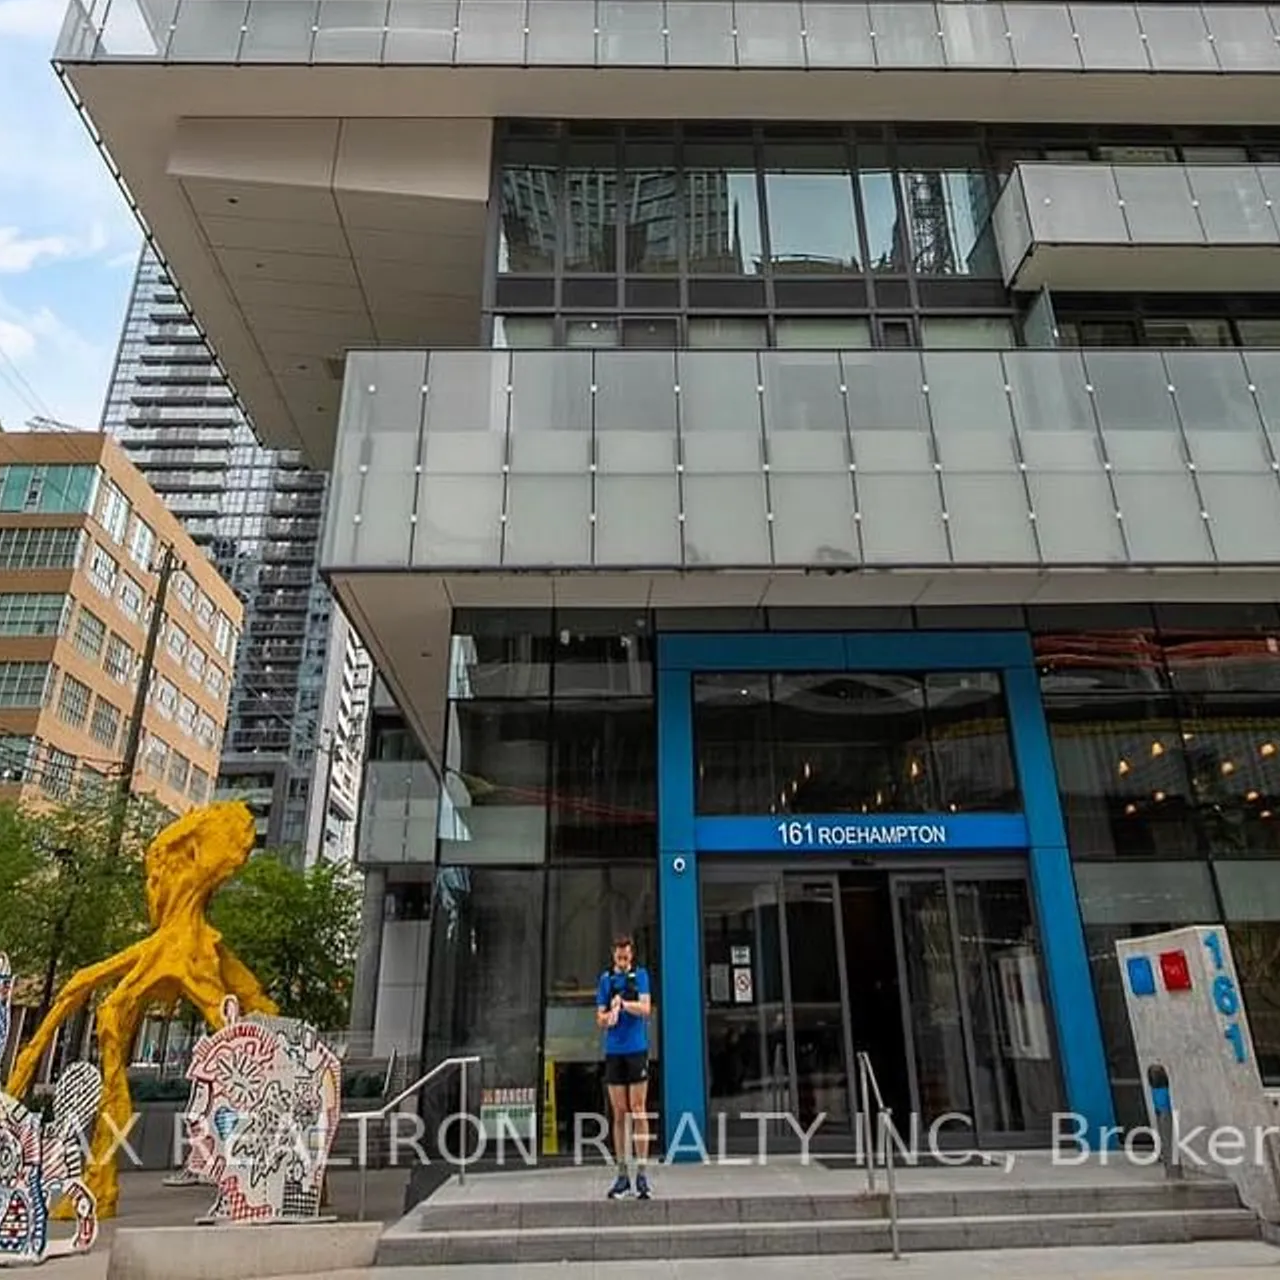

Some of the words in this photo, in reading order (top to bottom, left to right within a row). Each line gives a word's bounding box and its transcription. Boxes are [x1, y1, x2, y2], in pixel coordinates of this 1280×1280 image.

[778, 822, 813, 845] 161
[817, 824, 946, 844] ROEHAMPTON
[1204, 931, 1248, 1064] 161
